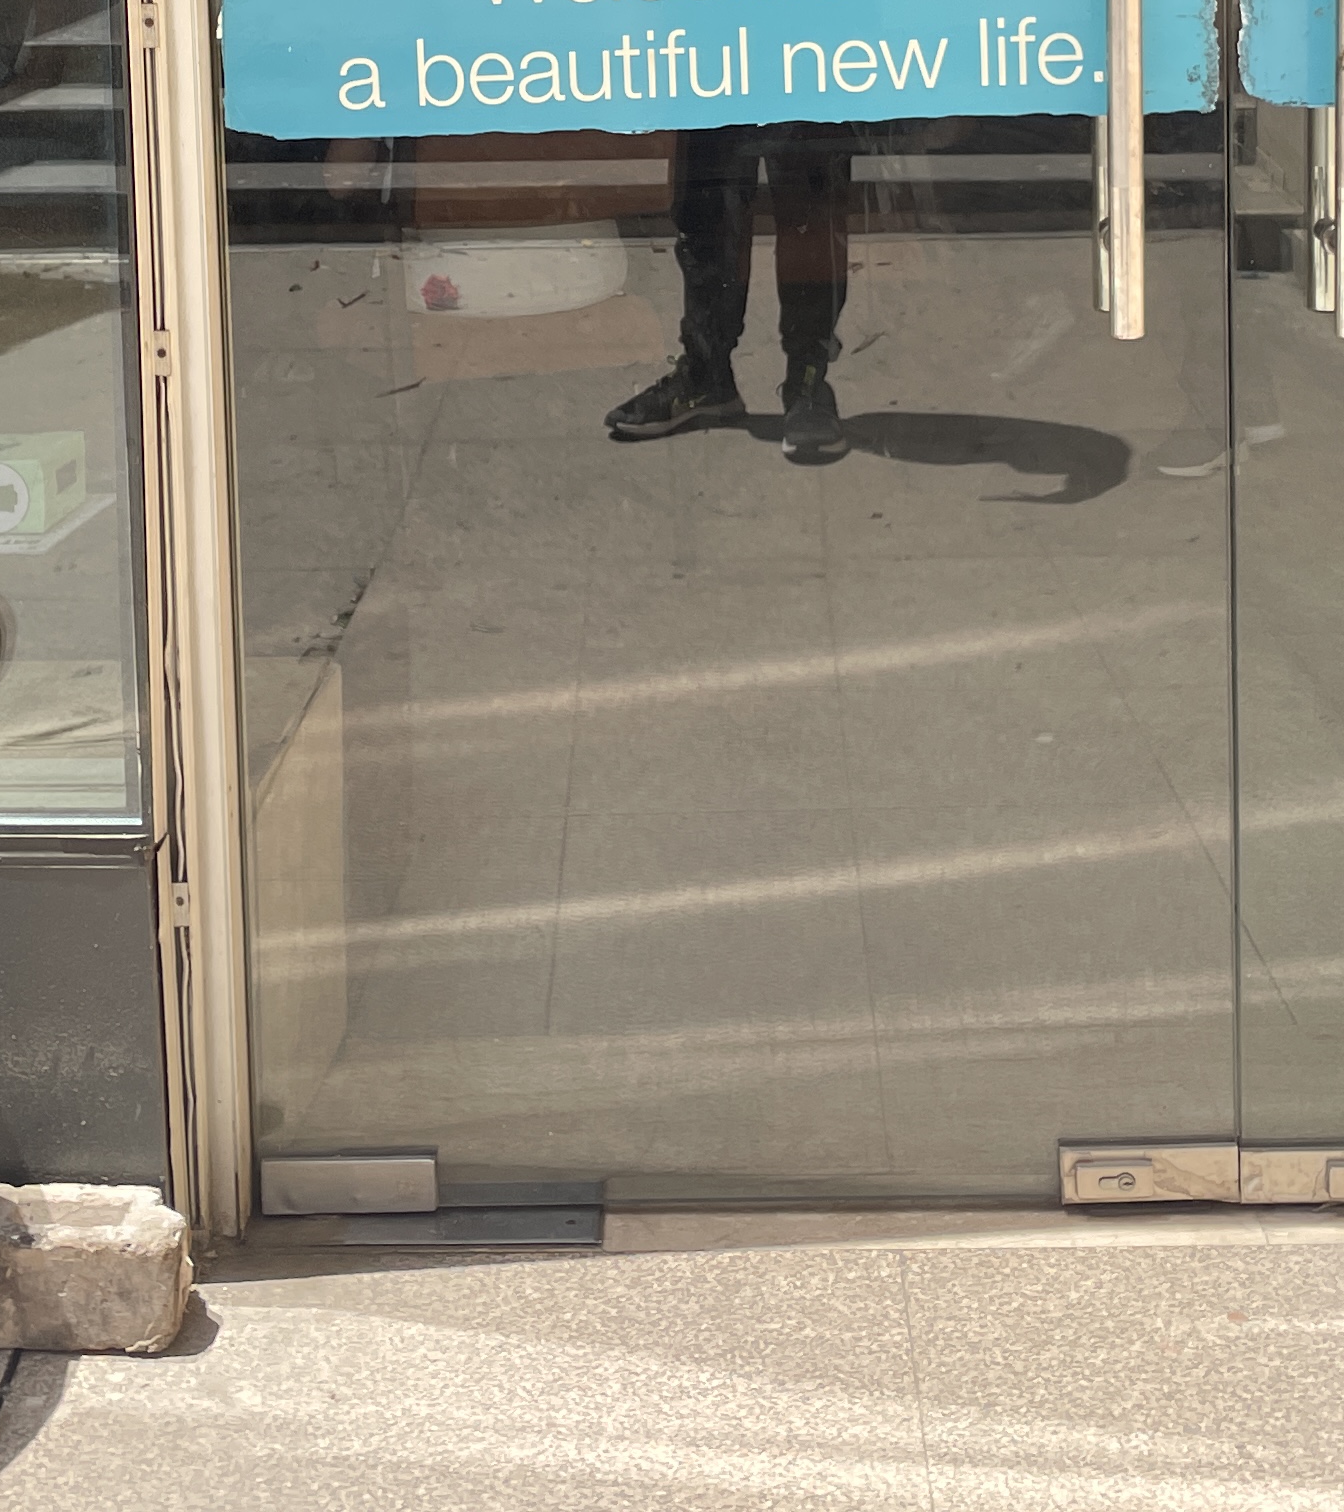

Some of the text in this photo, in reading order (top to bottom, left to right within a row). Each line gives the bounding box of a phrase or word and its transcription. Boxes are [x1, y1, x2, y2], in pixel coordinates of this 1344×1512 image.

[338, 16, 1104, 110] a beautiful new life.
